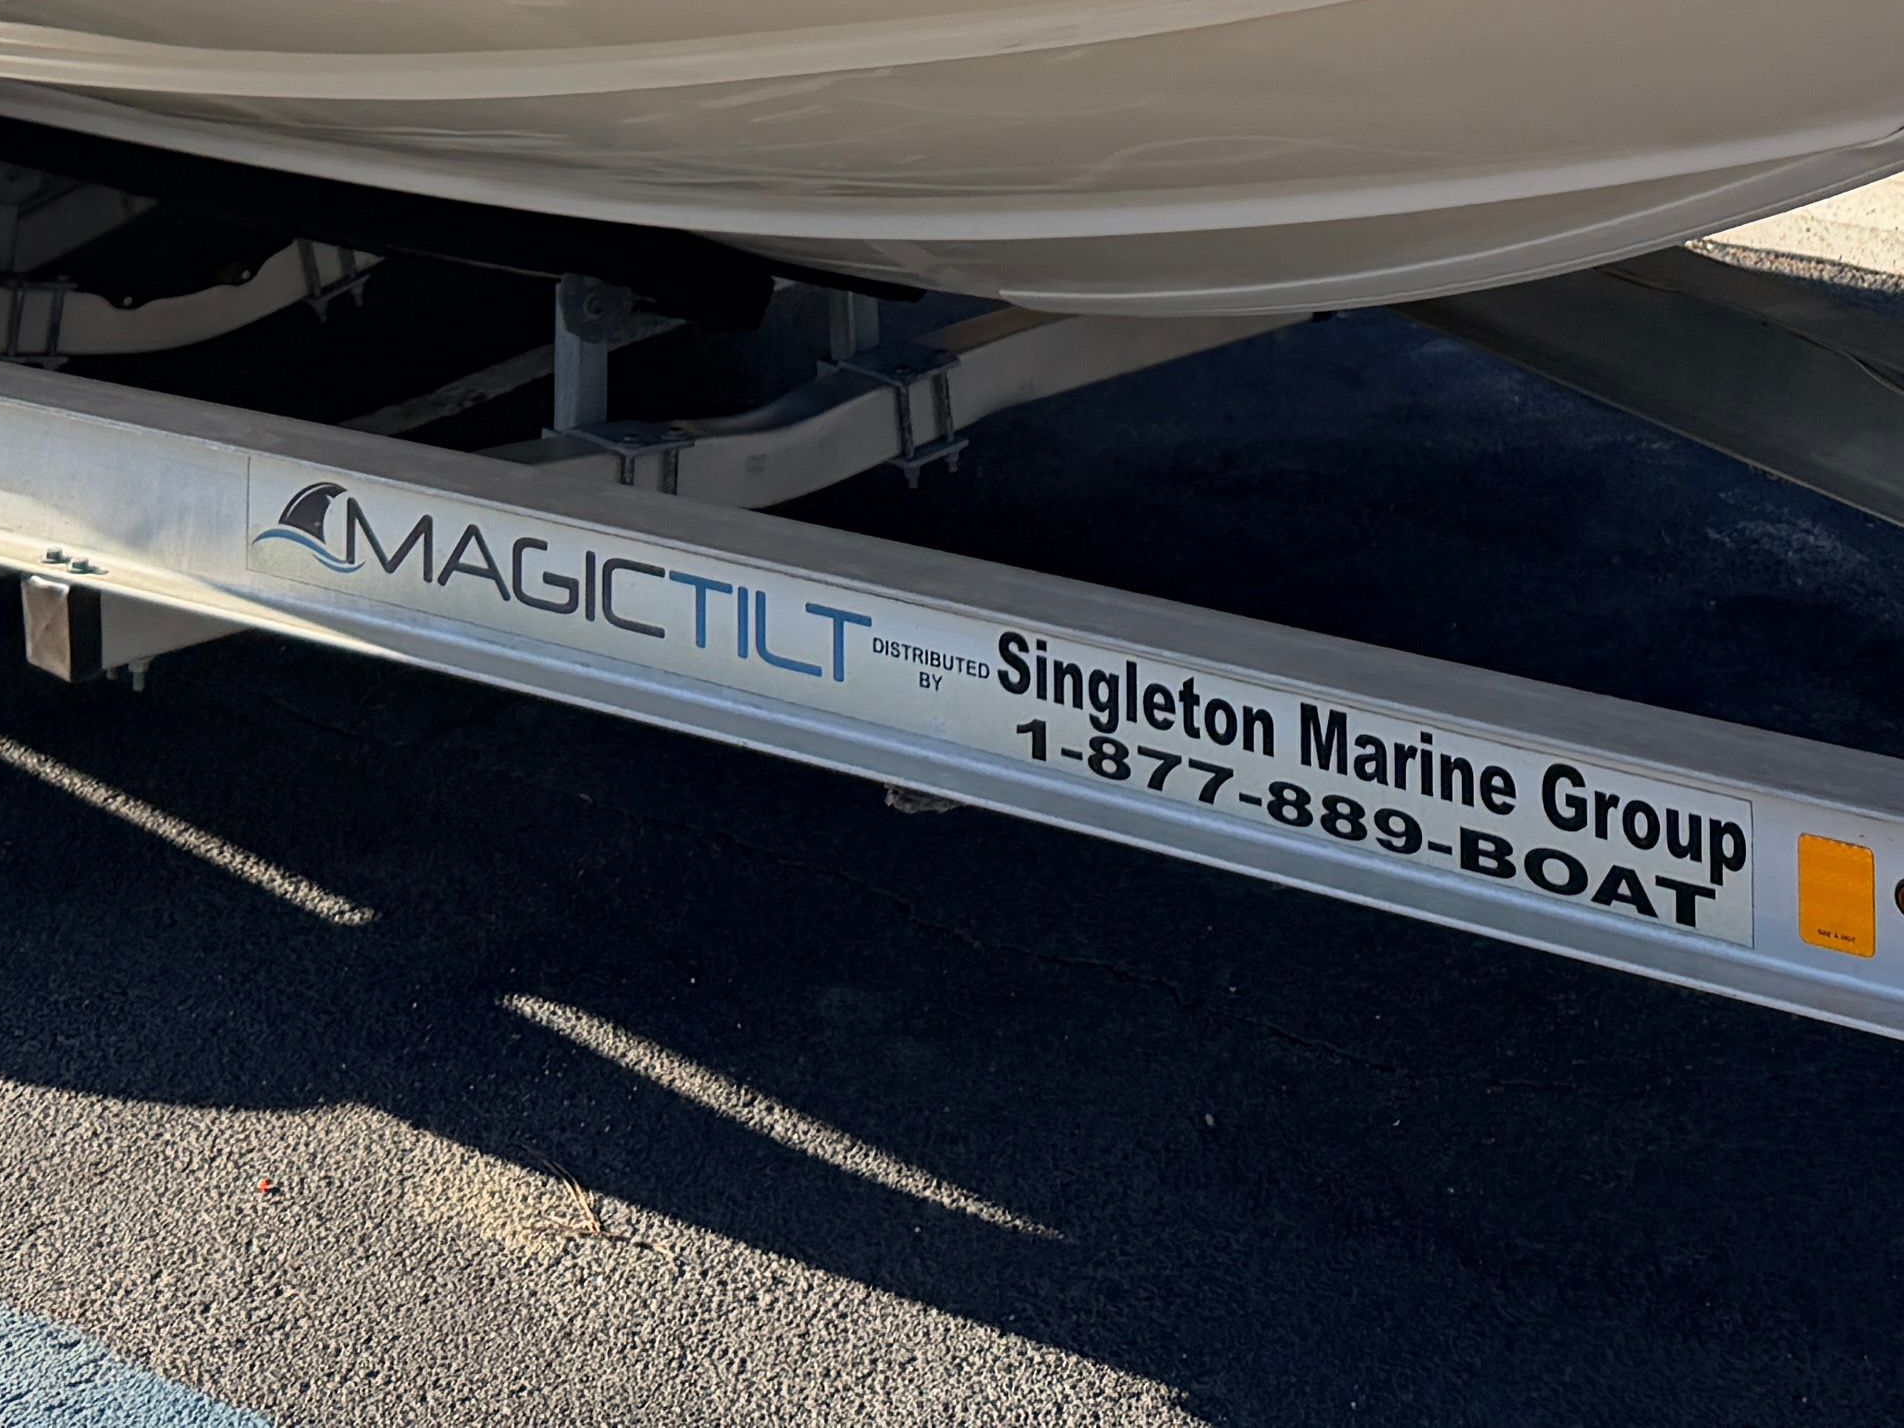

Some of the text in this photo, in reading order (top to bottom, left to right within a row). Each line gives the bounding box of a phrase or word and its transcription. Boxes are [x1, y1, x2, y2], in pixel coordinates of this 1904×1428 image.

[345, 496, 1747, 886] MAGICTILT DISTRIBUTED Singleton Marine Group
[918, 670, 943, 692] BY
[1016, 718, 1717, 928] 1-877-889-BOAT
